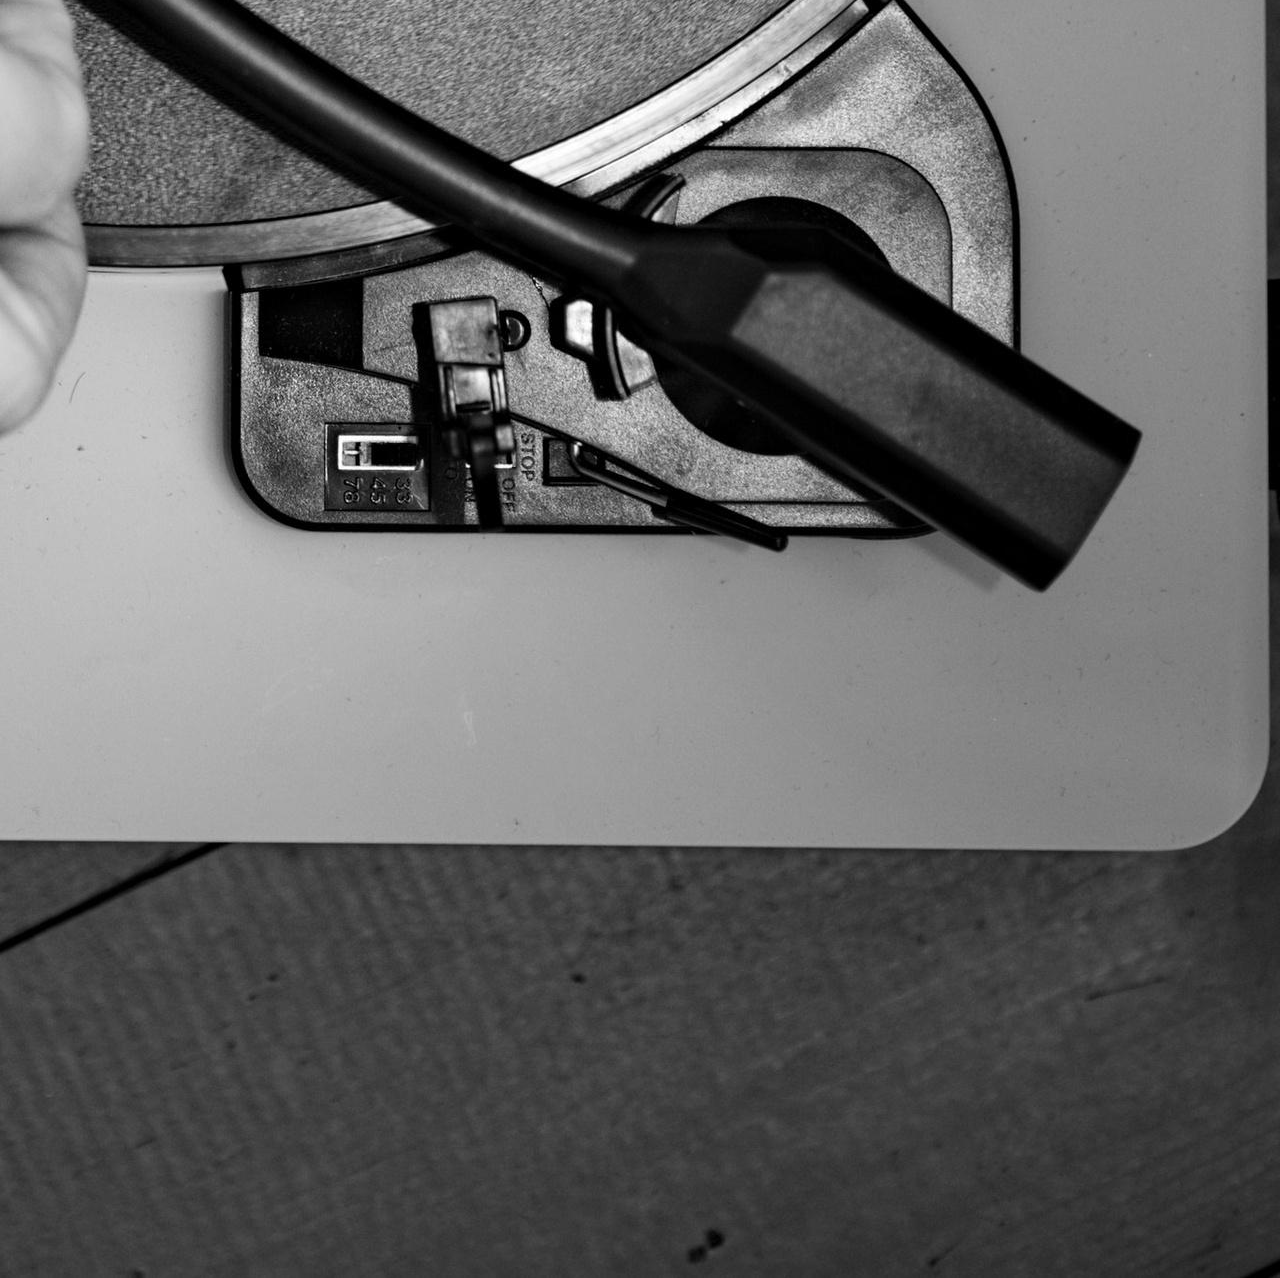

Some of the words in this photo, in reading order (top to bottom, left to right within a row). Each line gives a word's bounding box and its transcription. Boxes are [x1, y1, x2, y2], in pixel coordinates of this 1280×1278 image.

[521, 433, 535, 481] STOP
[343, 477, 361, 505] 78
[370, 477, 387, 505] 45
[395, 477, 412, 505] 33
[502, 477, 516, 513] OFF
